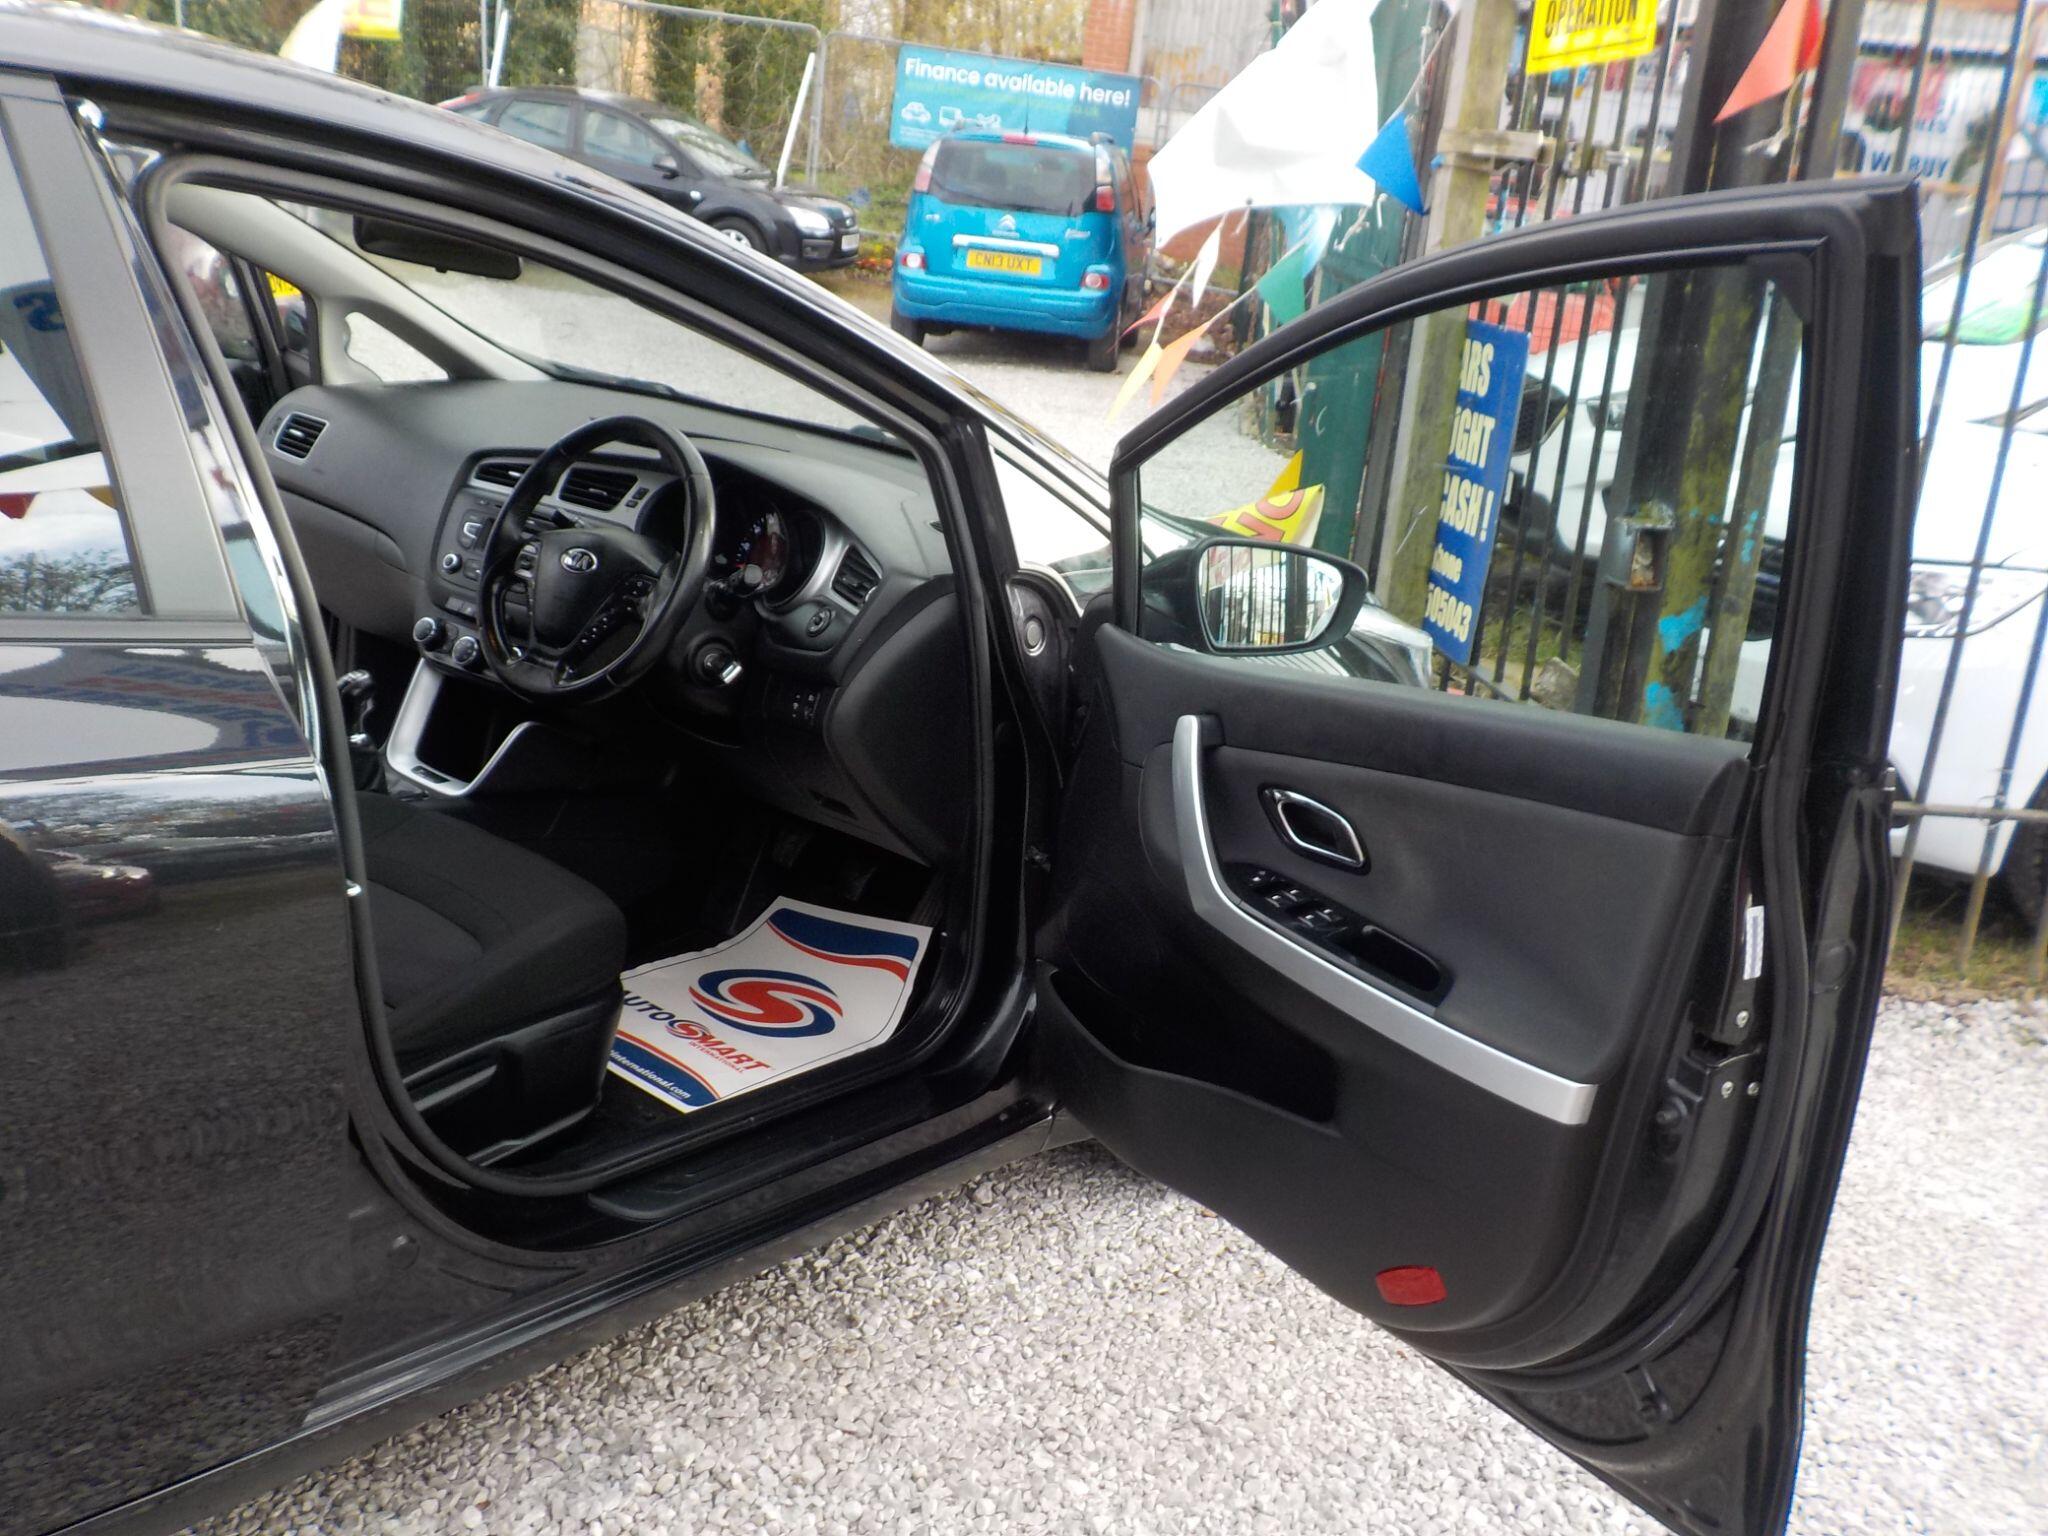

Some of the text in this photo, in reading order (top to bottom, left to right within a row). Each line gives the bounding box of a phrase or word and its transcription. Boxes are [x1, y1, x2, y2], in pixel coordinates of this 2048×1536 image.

[1545, 0, 1638, 38] OPERATION
[904, 57, 981, 86] Finance
[984, 72, 1076, 99] available
[1079, 82, 1131, 107] here!
[1007, 254, 1031, 271] UXT
[1432, 542, 1463, 584] hone
